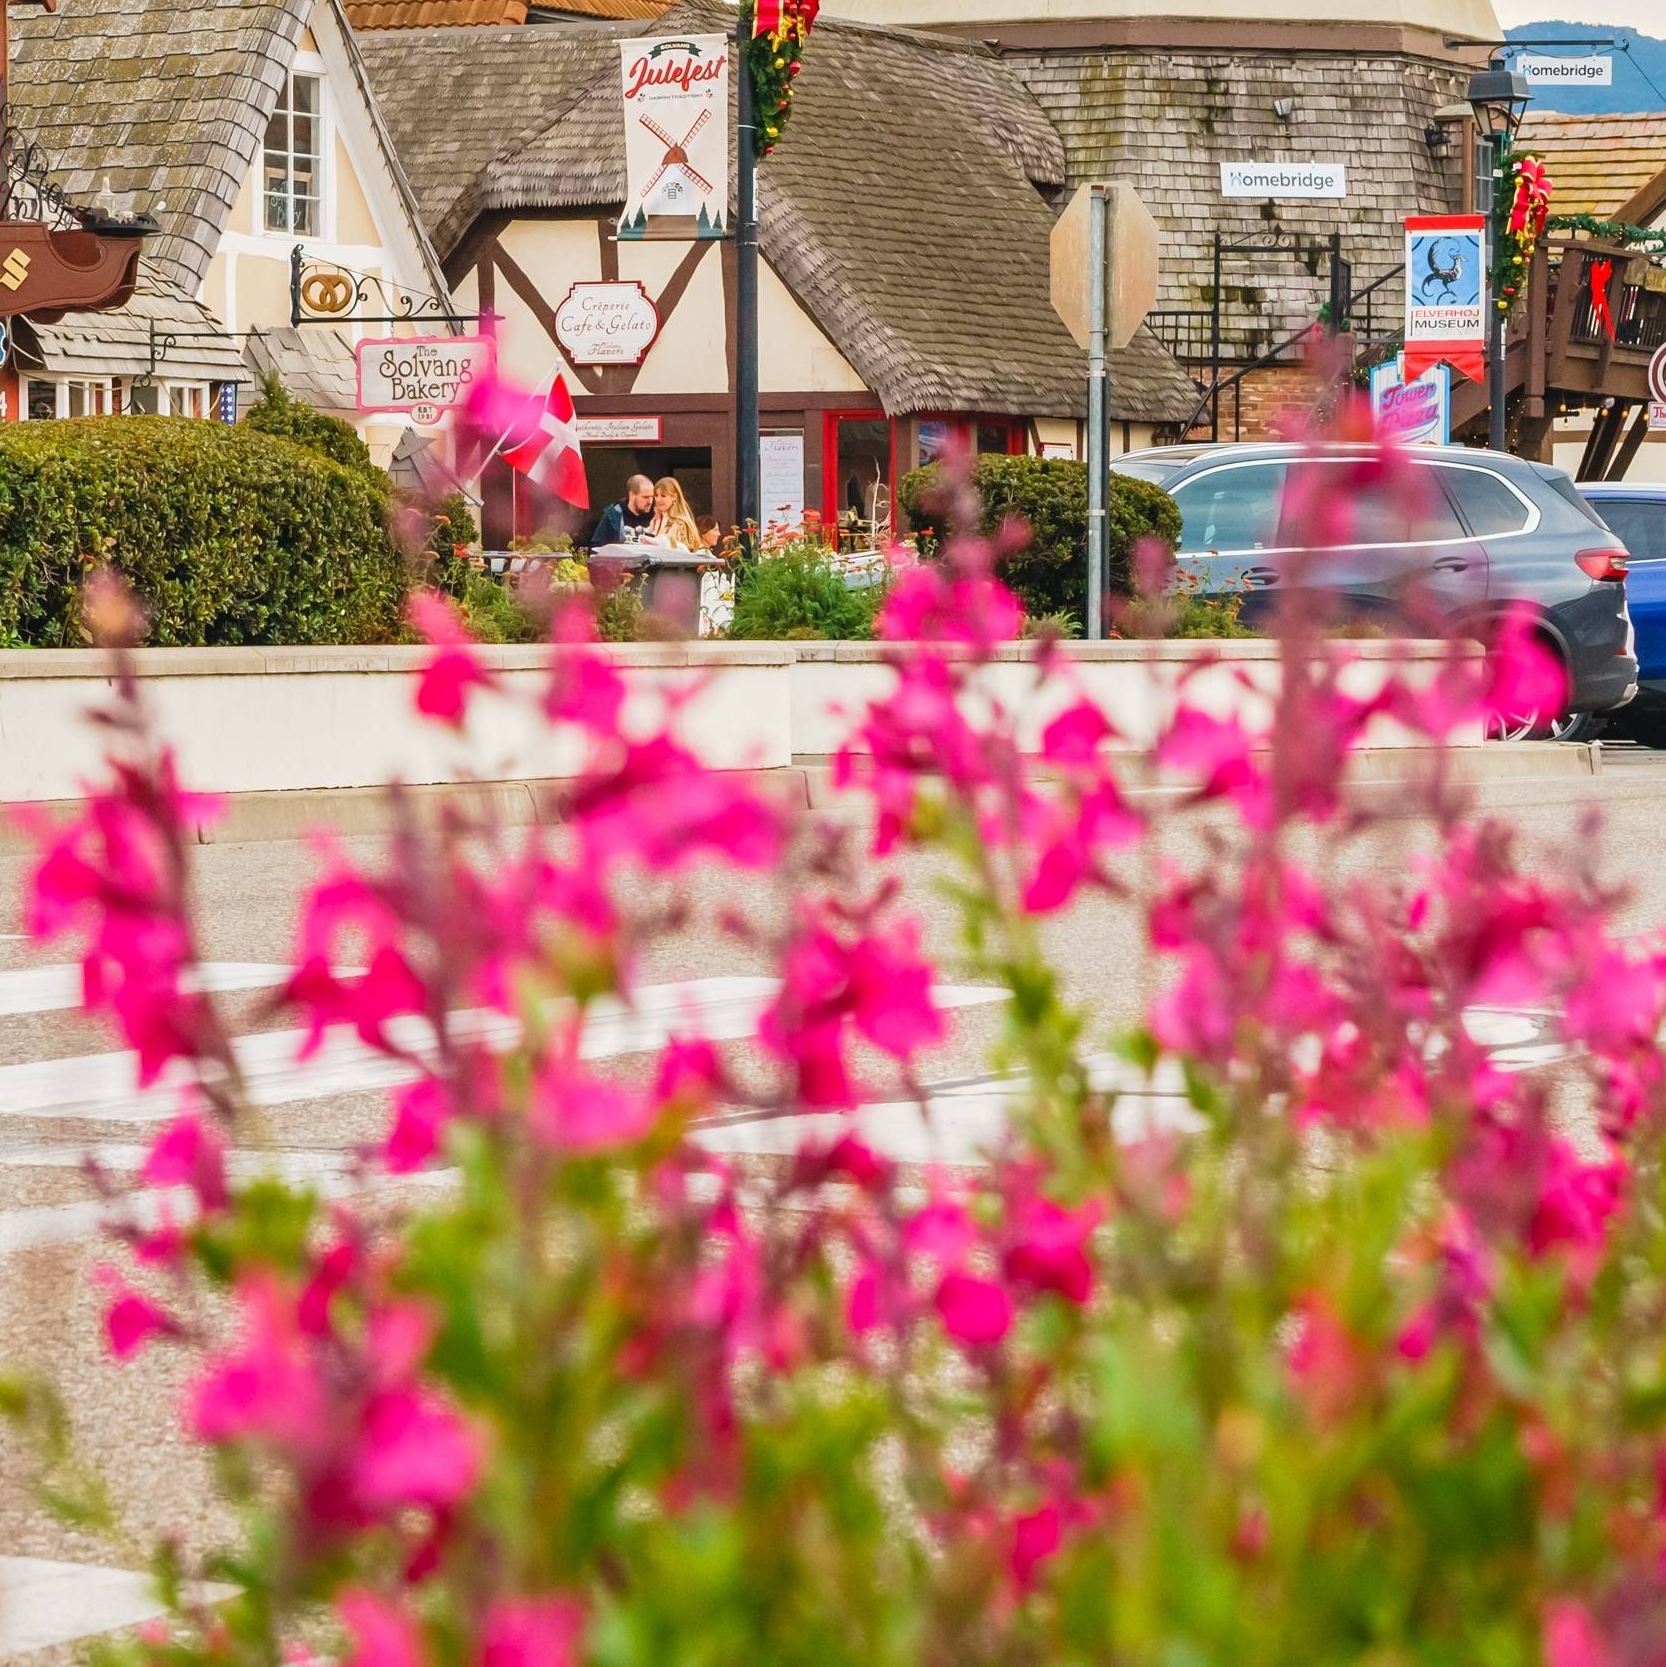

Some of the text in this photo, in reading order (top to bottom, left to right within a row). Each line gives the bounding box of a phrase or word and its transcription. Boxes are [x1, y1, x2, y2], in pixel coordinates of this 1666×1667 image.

[660, 42, 690, 50] SOLVANG
[625, 55, 726, 99] Julefest
[1523, 64, 1603, 78] Homebridge
[1230, 172, 1334, 190] Homebridge
[1415, 309, 1479, 318] ELVERHØJ
[595, 319, 605, 330] &
[606, 312, 651, 334] Gelato
[1414, 319, 1479, 329] MUSEUM
[417, 346, 437, 357] The
[379, 350, 472, 383] Solvang
[392, 378, 461, 403] Bakery
[575, 421, 603, 432] uthentic
